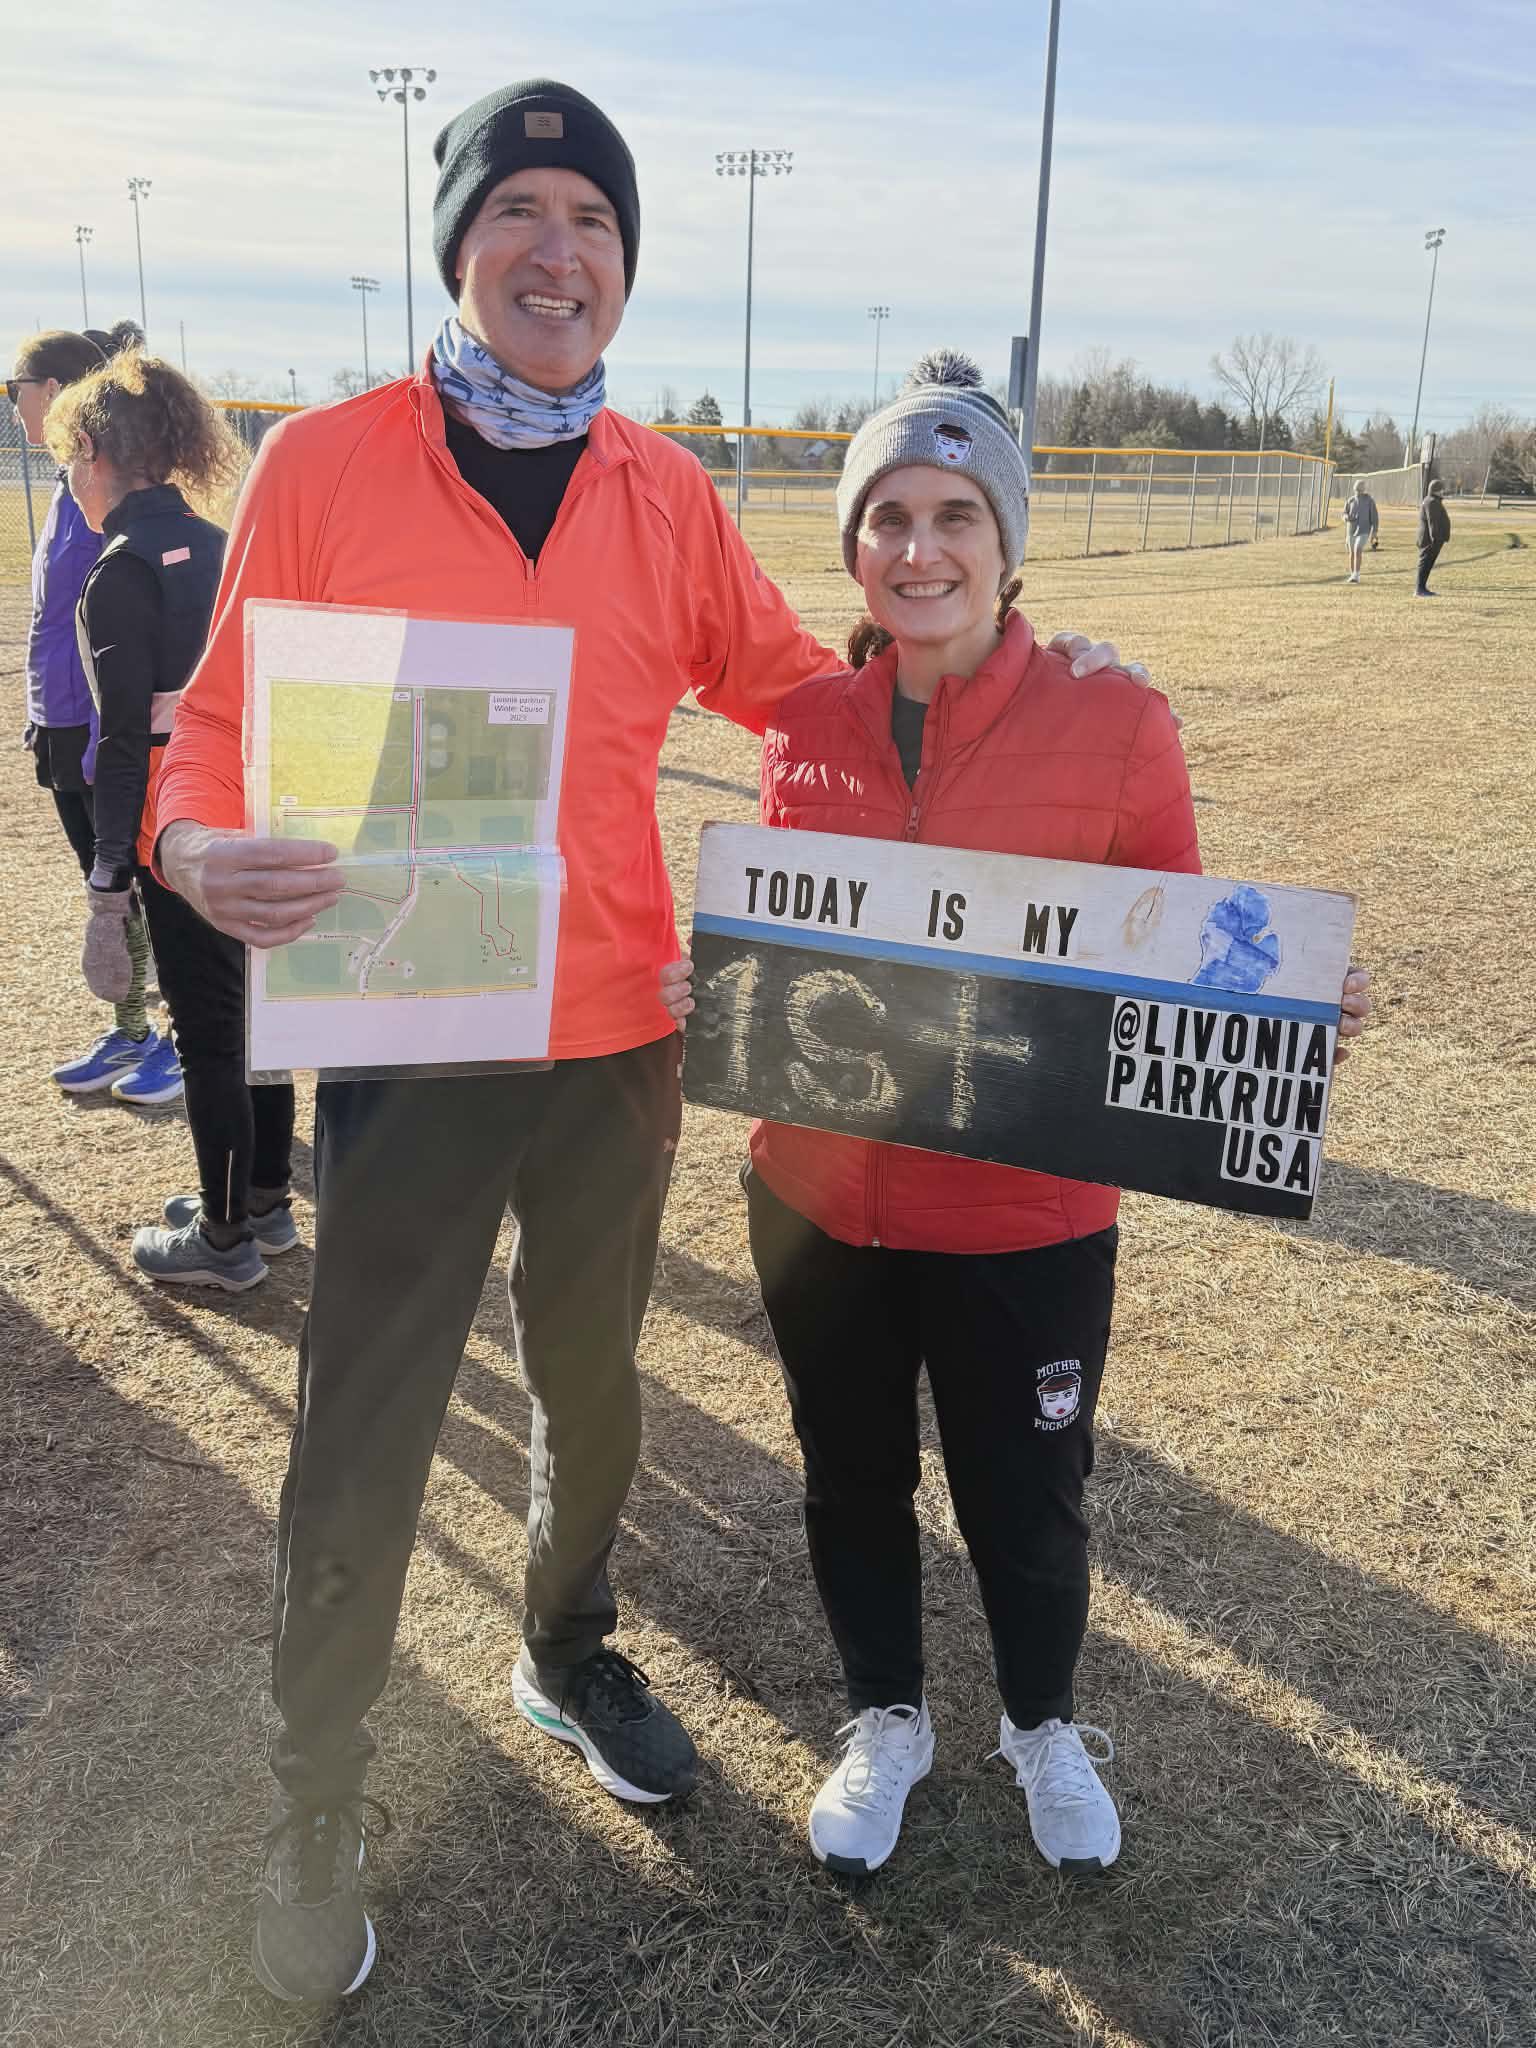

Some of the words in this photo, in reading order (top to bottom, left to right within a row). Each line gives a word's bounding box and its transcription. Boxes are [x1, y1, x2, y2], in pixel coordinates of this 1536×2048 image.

[745, 867, 869, 929] TODAY
[927, 889, 967, 942] IS
[1022, 903, 1080, 957] MY
[1113, 1000, 1328, 1078] @LIVONIA
[1110, 1054, 1325, 1134] PARKRUN
[1226, 1126, 1311, 1191] USA
[1036, 1359, 1082, 1380] MOTHER
